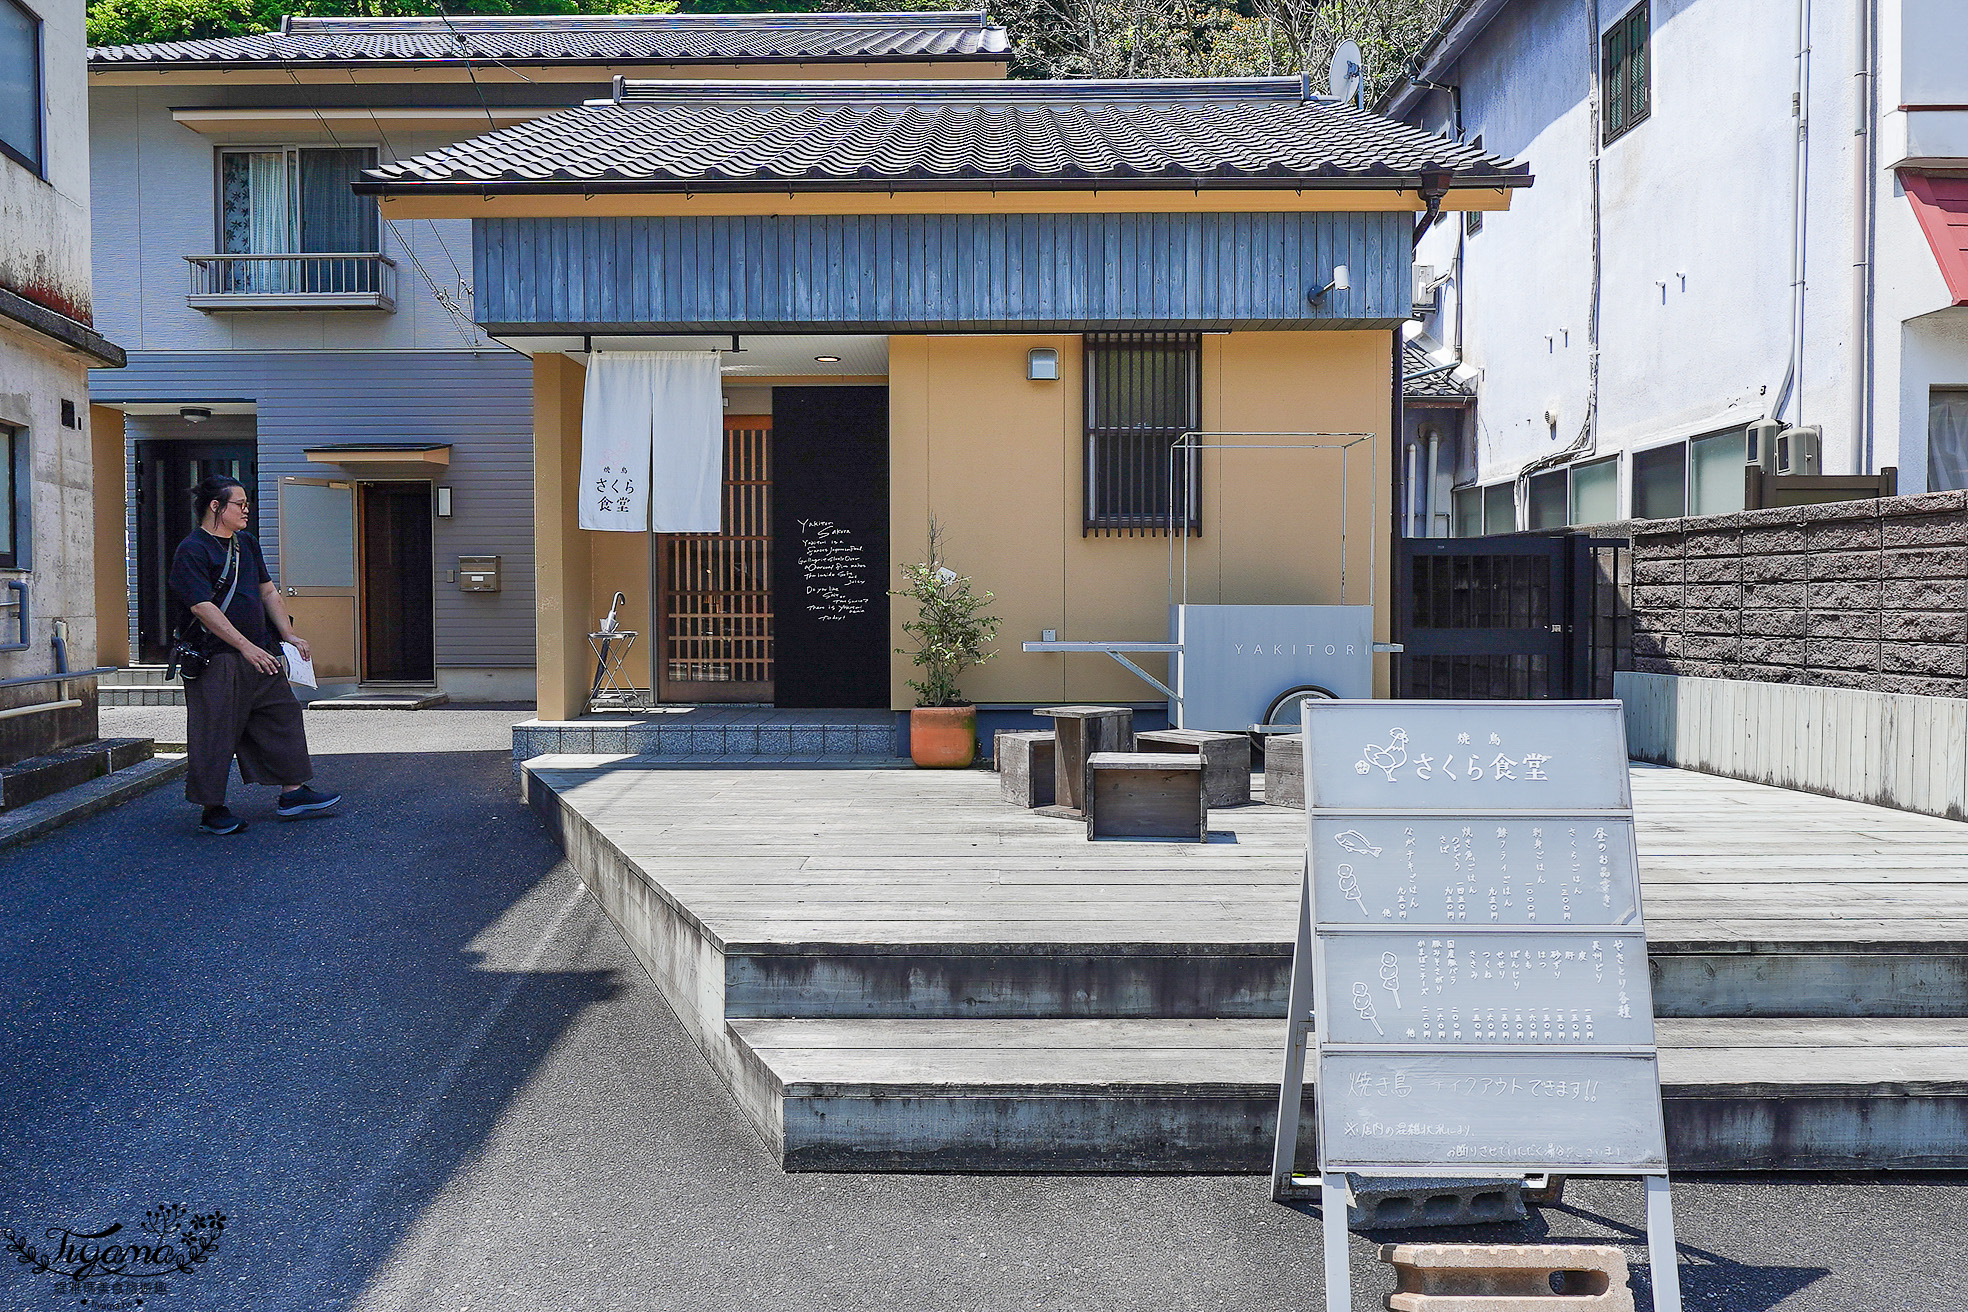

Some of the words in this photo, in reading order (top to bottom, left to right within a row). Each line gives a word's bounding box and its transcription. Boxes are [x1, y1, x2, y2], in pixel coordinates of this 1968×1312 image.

[596, 478, 634, 494] さくら
[598, 496, 630, 512] 食堂
[1235, 644, 1367, 655] YAKITORI
[1413, 753, 1552, 780] さくら食堂
